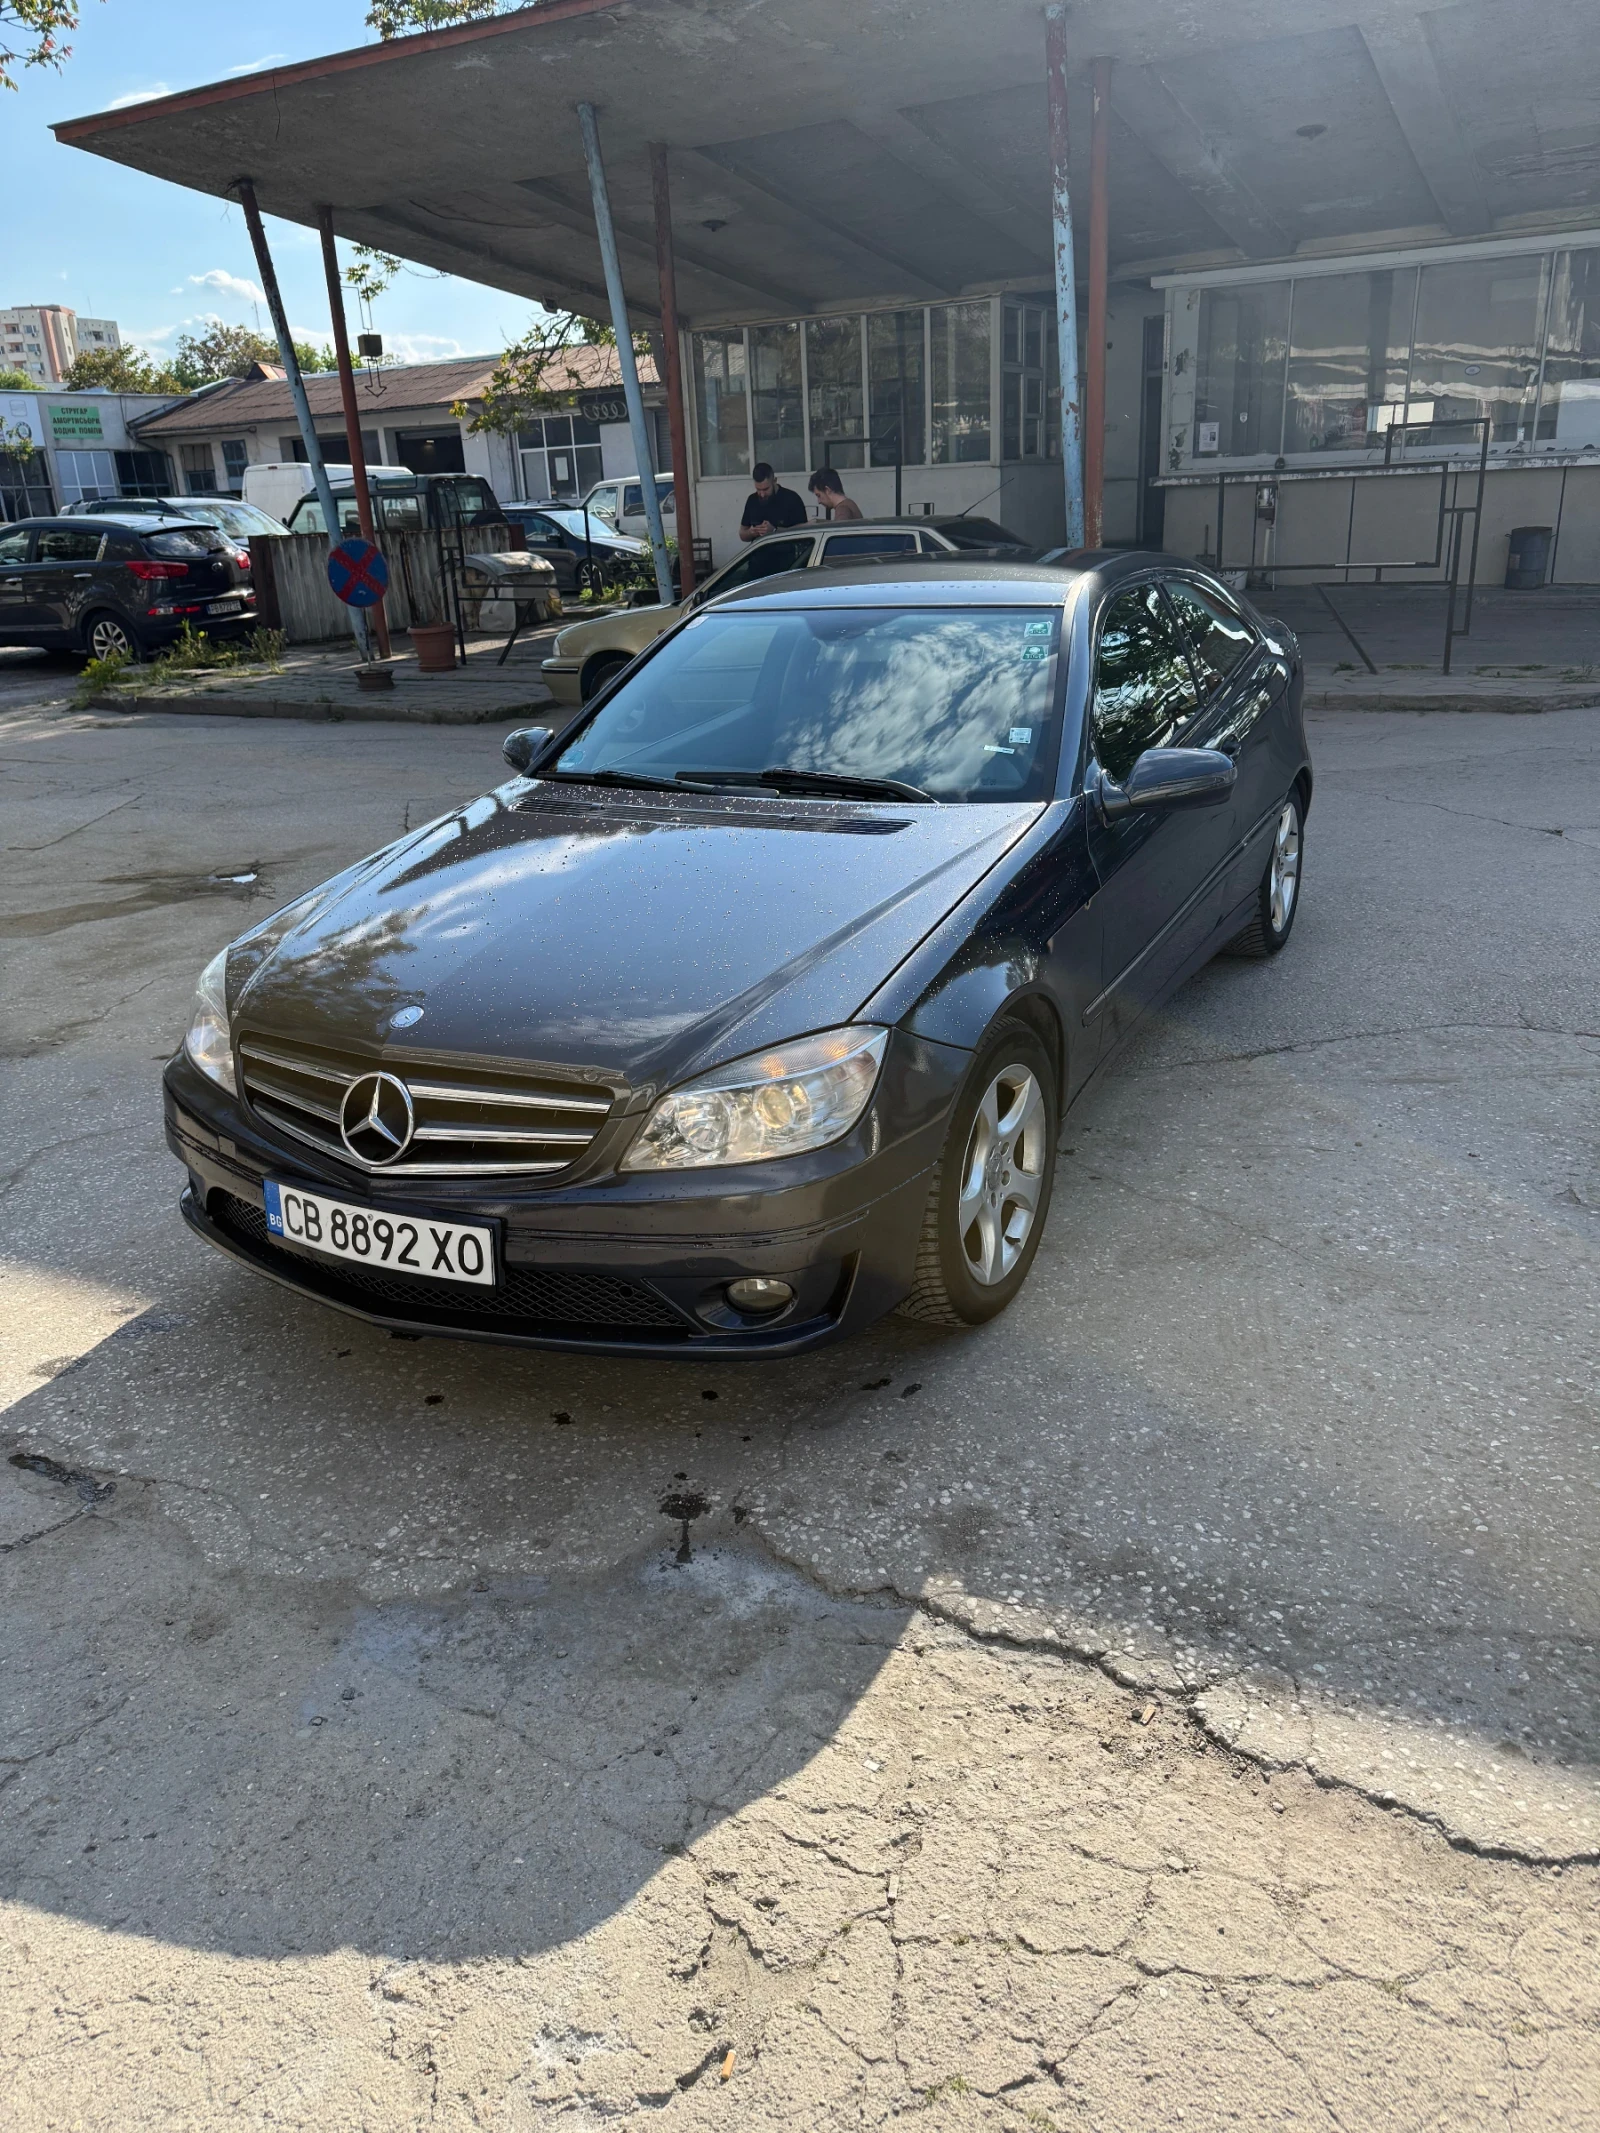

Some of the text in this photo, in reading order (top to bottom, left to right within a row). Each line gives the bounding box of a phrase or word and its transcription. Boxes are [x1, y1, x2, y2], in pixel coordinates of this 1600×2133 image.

[53, 427, 103, 435] ВОДНИ ПОМПИ
[269, 1213, 282, 1228] BG
[284, 1194, 484, 1276] CB 8892 XO
